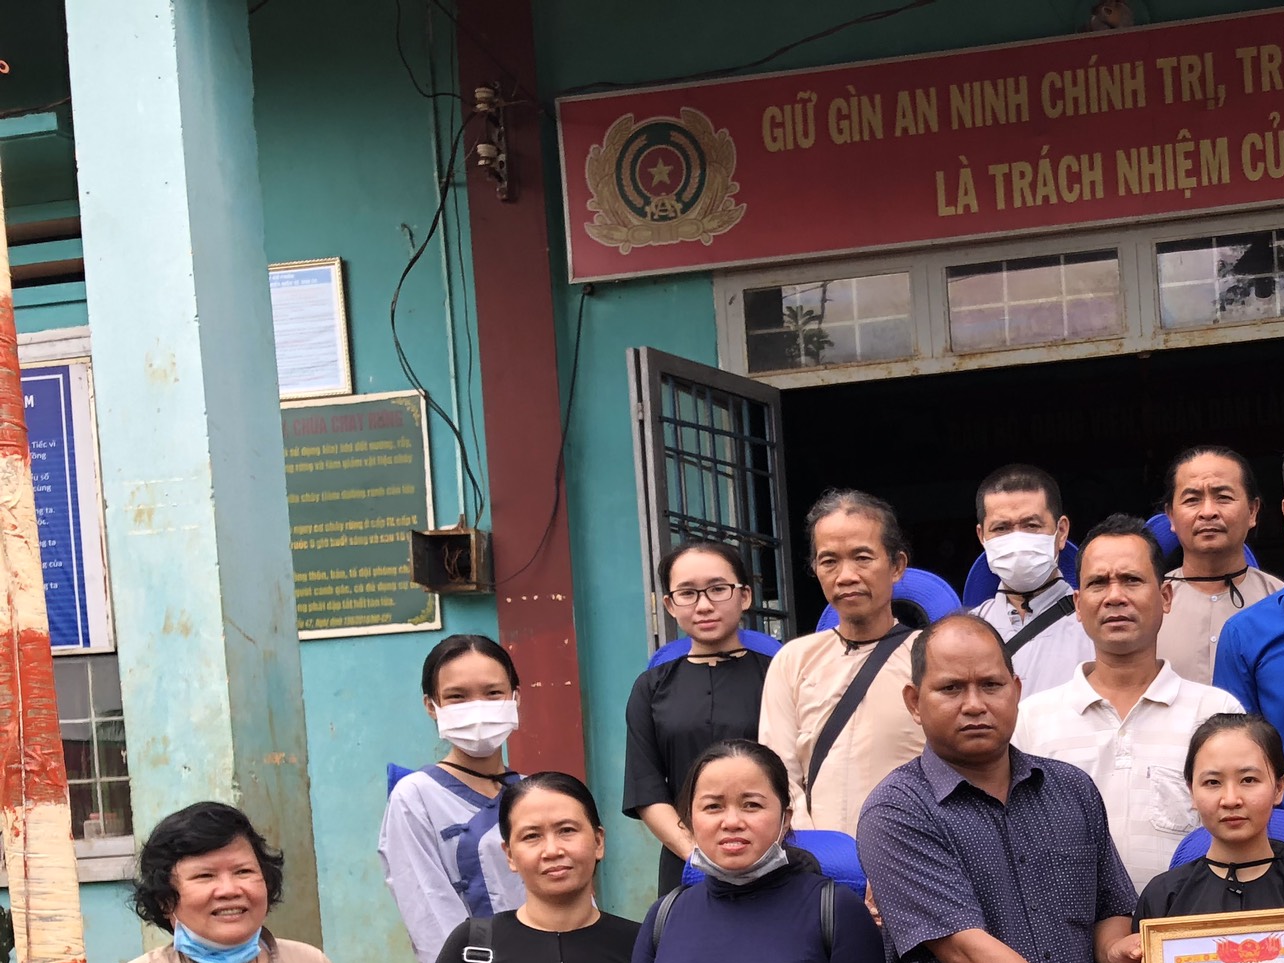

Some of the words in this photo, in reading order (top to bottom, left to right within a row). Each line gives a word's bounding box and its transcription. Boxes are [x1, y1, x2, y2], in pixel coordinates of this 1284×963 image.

[761, 91, 818, 153] GIỮ
[827, 86, 884, 146] GÌN
[895, 88, 939, 137] AN
[950, 76, 1029, 130] NINH
[1041, 55, 1146, 119] CHÍNH
[1156, 53, 1227, 110] TRỊ,
[935, 155, 980, 217] LÀ
[989, 144, 1105, 211] TRÁCH
[1117, 128, 1231, 199] NHIỆM
